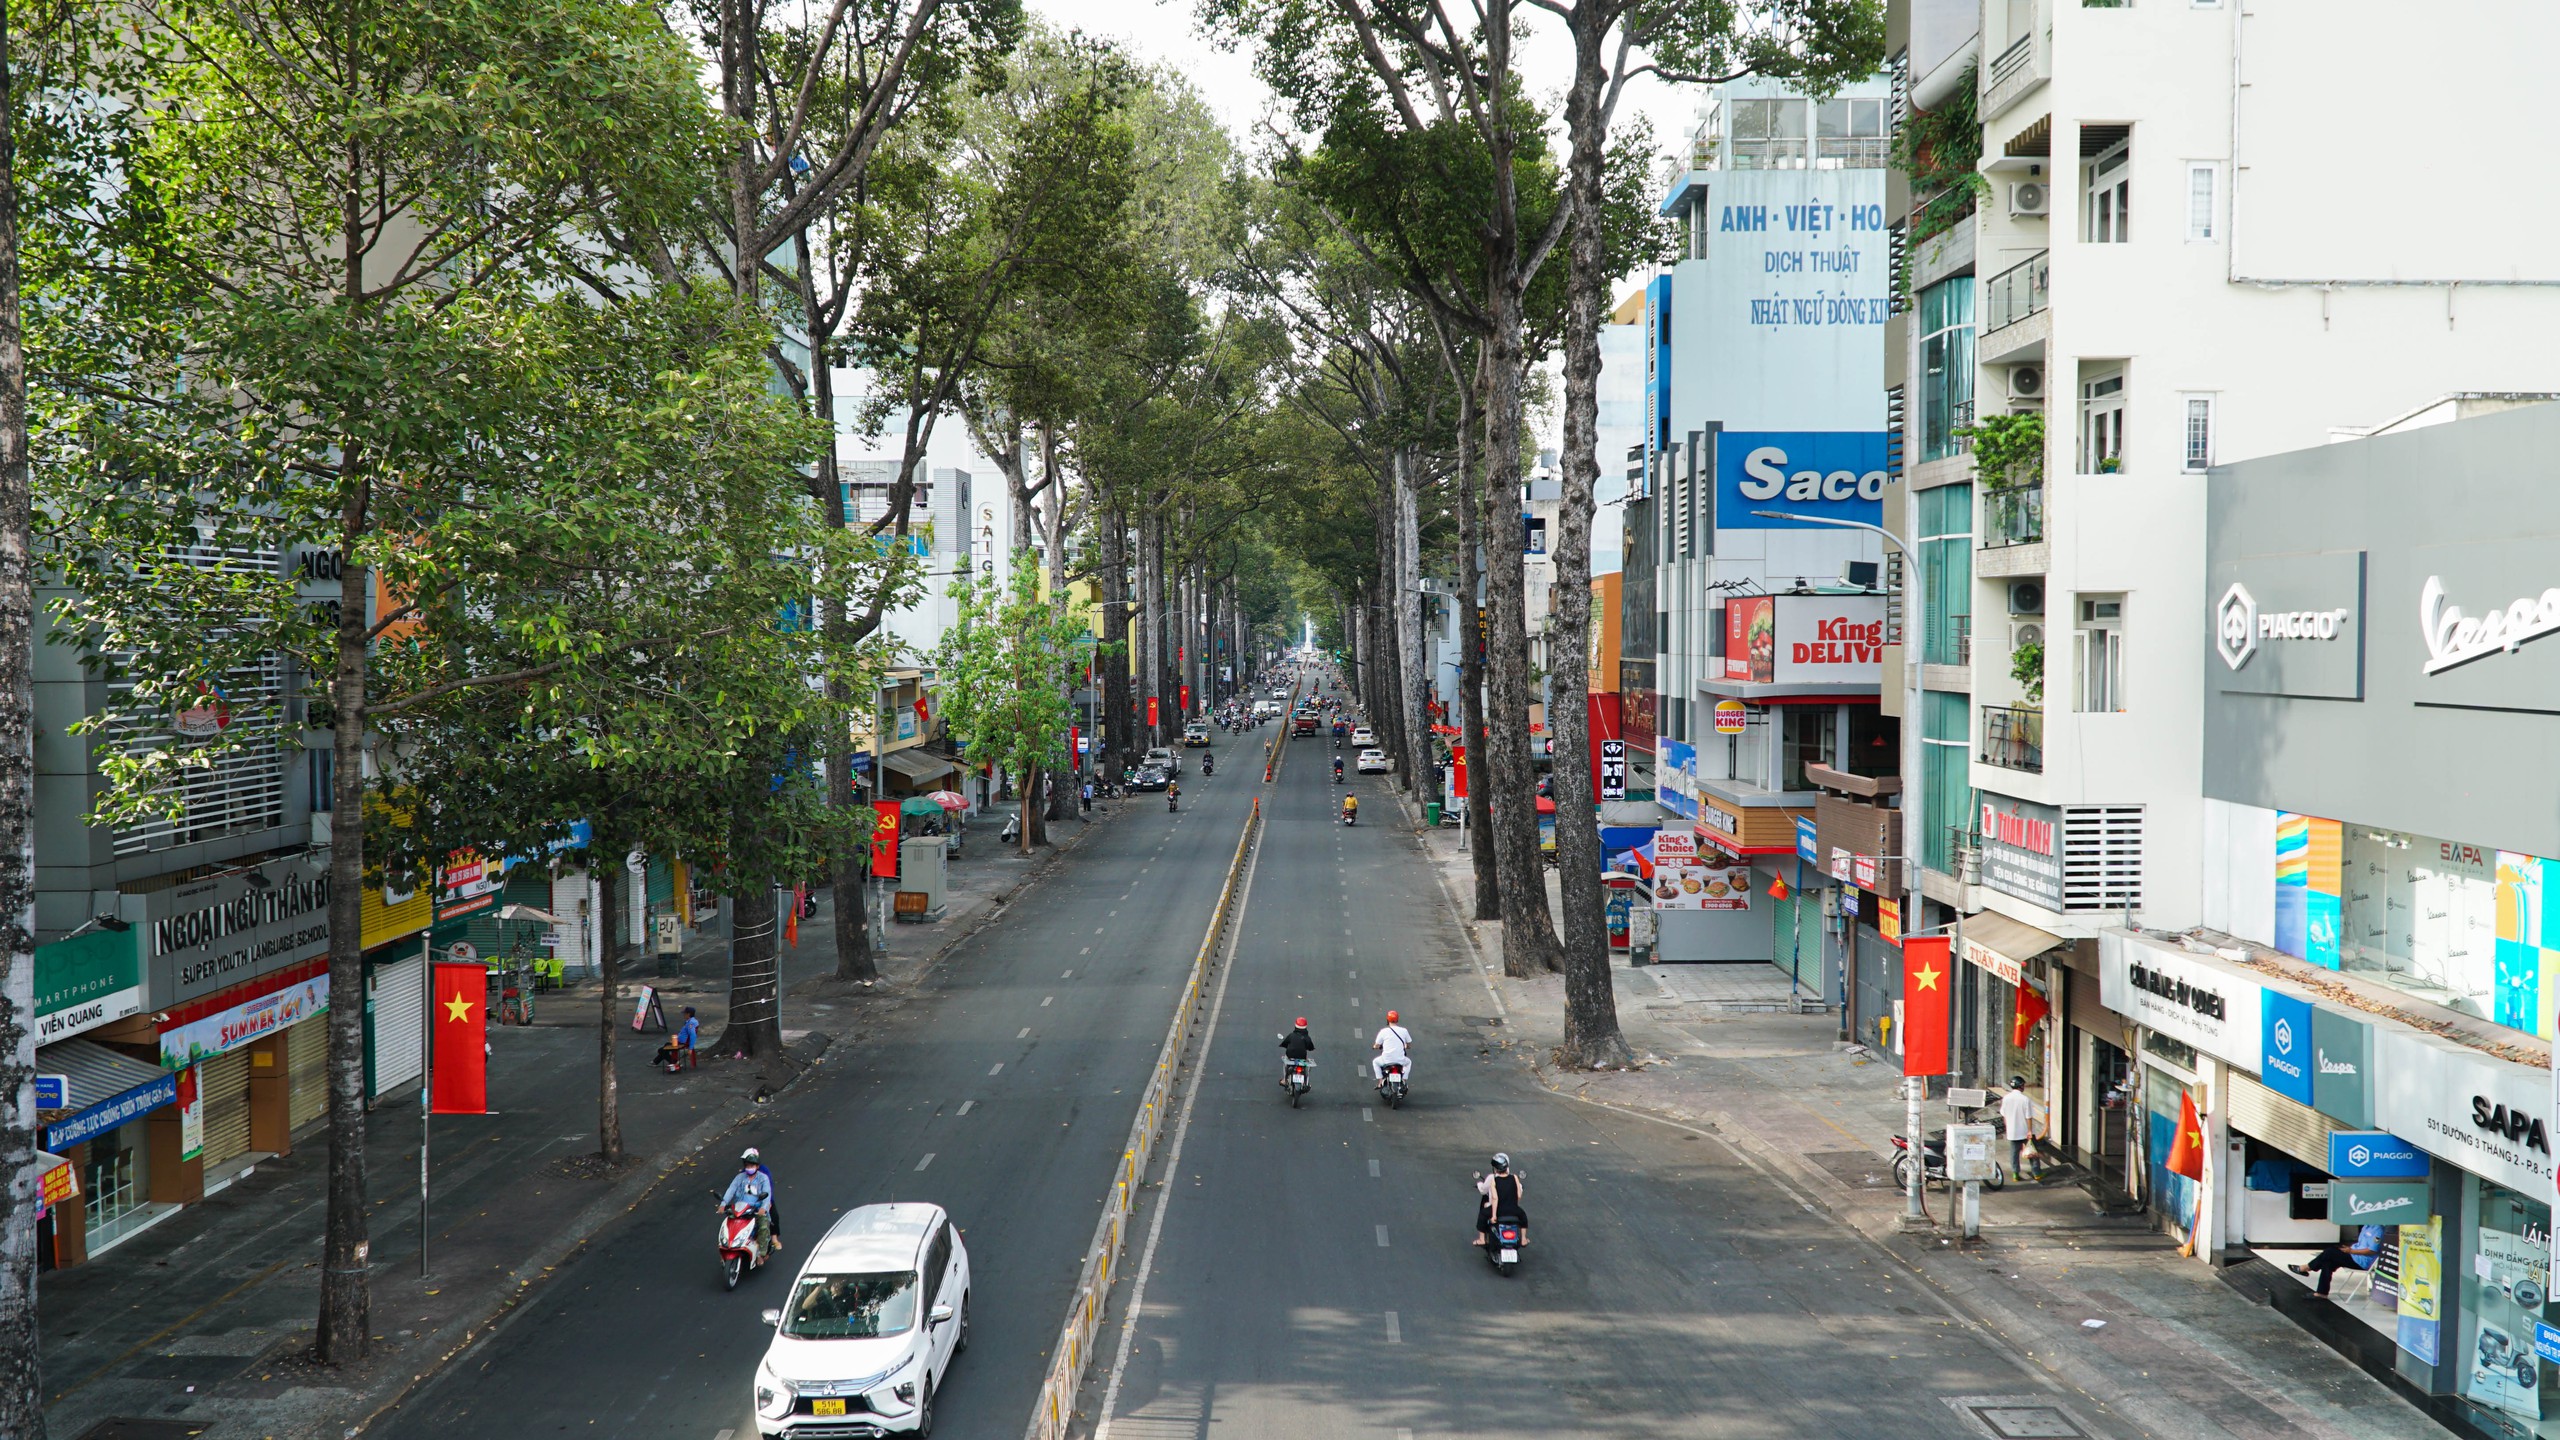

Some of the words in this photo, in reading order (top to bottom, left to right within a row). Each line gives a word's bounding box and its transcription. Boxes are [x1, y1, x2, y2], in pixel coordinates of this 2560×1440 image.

[1720, 206, 1767, 232] ANH
[1785, 197, 1834, 239] VIỆT
[1765, 251, 1802, 278] DỊCH
[1810, 244, 1861, 278] THUẬT
[1751, 290, 1789, 332] NHẬT
[1793, 289, 1825, 325] NGỮ
[1827, 290, 1866, 325] ĐÔNG
[1739, 446, 1888, 501] Saco
[1818, 617, 1883, 647] King
[2258, 611, 2341, 641] PIAGGIO
[2420, 575, 2560, 674] Vespa
[1716, 710, 1745, 718] BURGER
[1716, 718, 1745, 727] KING
[1604, 764, 1613, 776] Dr
[1613, 764, 1623, 776] ST
[1658, 834, 1688, 845] King's
[1998, 802, 2027, 849] TUẤN
[2026, 817, 2055, 857] ANH
[1658, 844, 1694, 852] Choice
[2441, 843, 2483, 867] SAPA
[155, 906, 219, 957] NGOẠI
[220, 888, 260, 937] NGỮ
[181, 961, 215, 986] SUPER
[216, 949, 248, 974] YOUTH
[249, 935, 295, 963] LANGUAGE
[296, 924, 329, 947] SCHOOL
[1970, 946, 1994, 970] TUẤN
[1997, 961, 2019, 983] ANH
[41, 1014, 65, 1036] VIỄN
[68, 1004, 103, 1028] QUANG
[220, 1009, 275, 1048] SUMMER
[279, 997, 302, 1022] JOY
[2268, 1055, 2299, 1078] PIAGGIO
[2319, 1048, 2356, 1074] Vespa
[100, 1102, 120, 1128] CHỐNG
[2472, 1095, 2551, 1156] SAPA
[2373, 1152, 2413, 1160] PIAGGIO
[2427, 1118, 2440, 1132] 531
[2442, 1124, 2473, 1146] ĐƯỜNG
[2475, 1138, 2480, 1149] 3
[2482, 1140, 2511, 1162] THÁNG
[2514, 1154, 2519, 1166] 2
[2526, 1159, 2539, 1174] P.8
[2349, 1194, 2413, 1216] Vespa
[2522, 1222, 2541, 1249] LÁI
[2485, 1248, 2504, 1260] ĐỊNH
